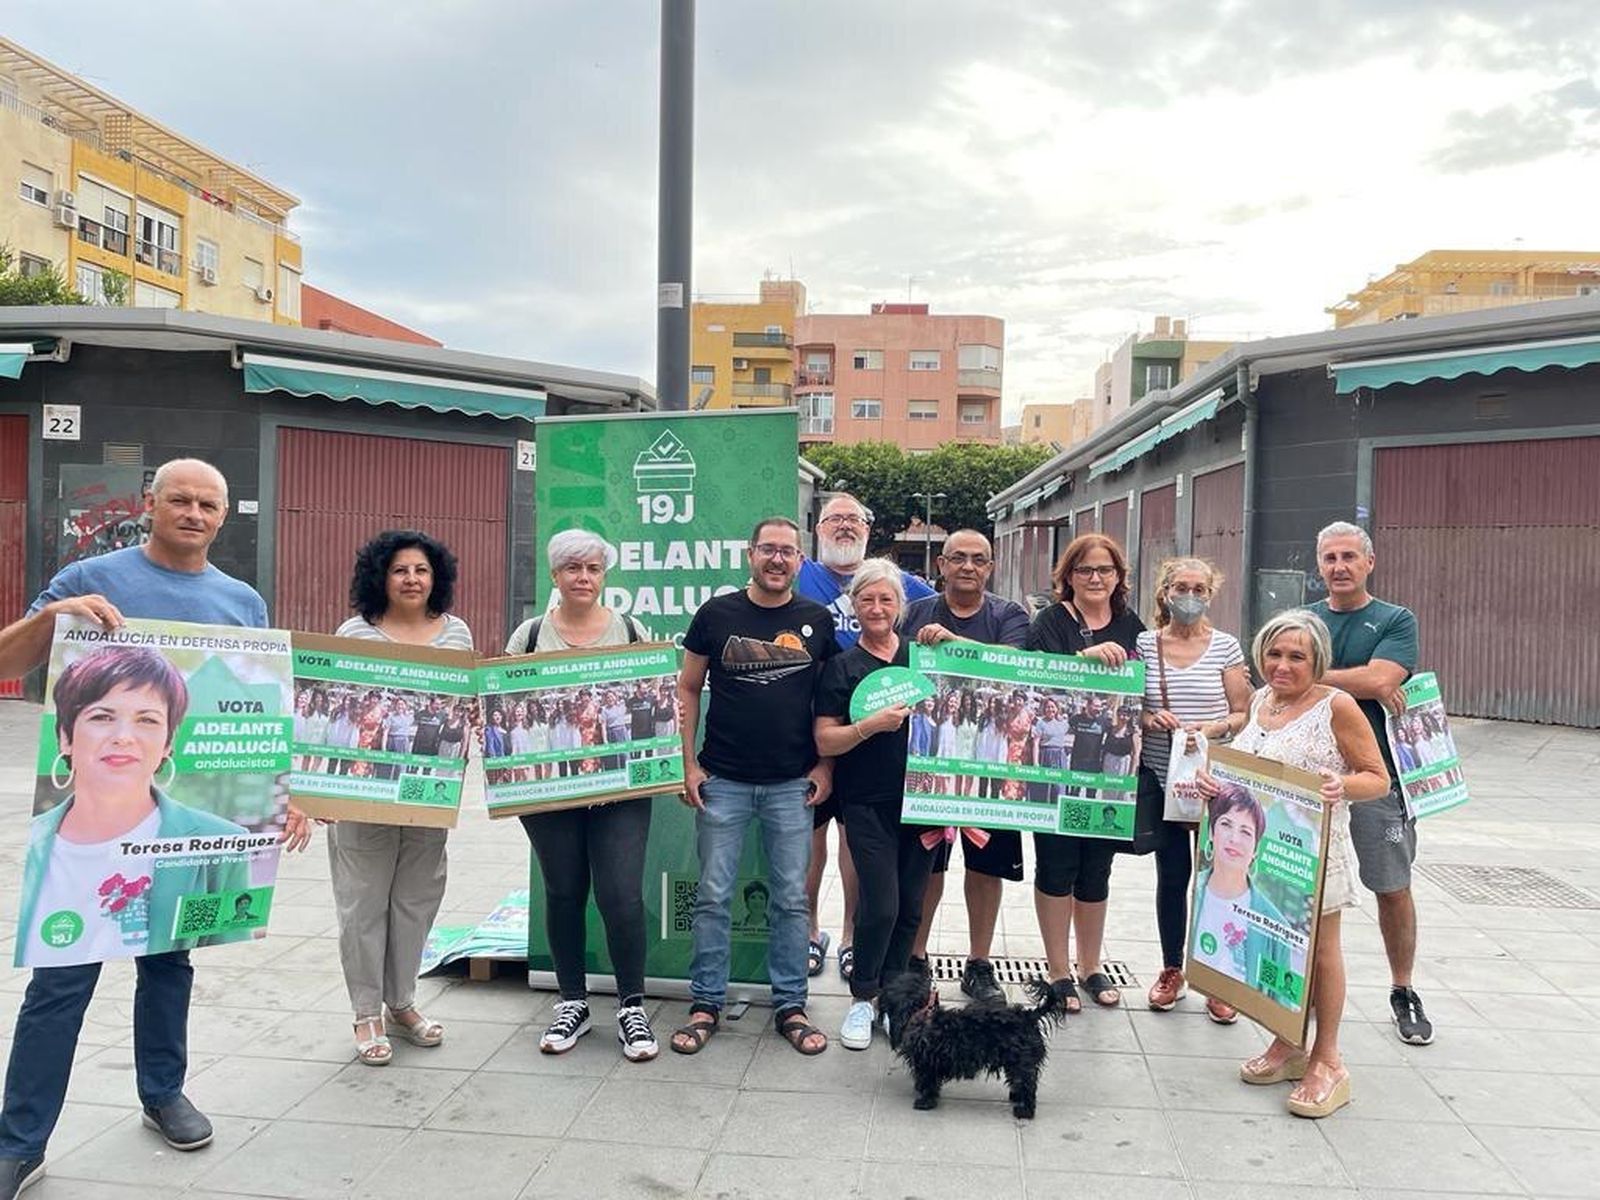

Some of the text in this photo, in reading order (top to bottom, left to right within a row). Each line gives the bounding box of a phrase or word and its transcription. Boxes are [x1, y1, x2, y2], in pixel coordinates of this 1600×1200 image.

[50, 418, 74, 433] 22
[522, 452, 535, 465] 21
[637, 494, 695, 524] 19J
[606, 540, 748, 571] ELANT
[64, 629, 288, 653] ANDALUCÍA EN DEFENSA PROPIA
[298, 655, 332, 667] VOTA
[335, 660, 397, 676] ADELANTE
[505, 653, 668, 678] VOTA ADELANTE ANDALUCÍA
[944, 647, 978, 660] VOTA
[982, 651, 1043, 667] ADELANTE
[218, 701, 264, 713] VOTA
[192, 722, 284, 736] ADELANTE
[182, 737, 289, 755] ANDALUCÍA
[194, 757, 276, 769] andalucistas
[974, 808, 1014, 818] DEFENSA
[1016, 811, 1055, 823] PROPIA
[121, 836, 275, 855] Teresa Rodríguez
[1279, 831, 1303, 848] VOTA
[1266, 841, 1312, 867] ADELANTE
[1260, 852, 1313, 882] ANDALUCÍA
[1233, 903, 1262, 923] Teresa
